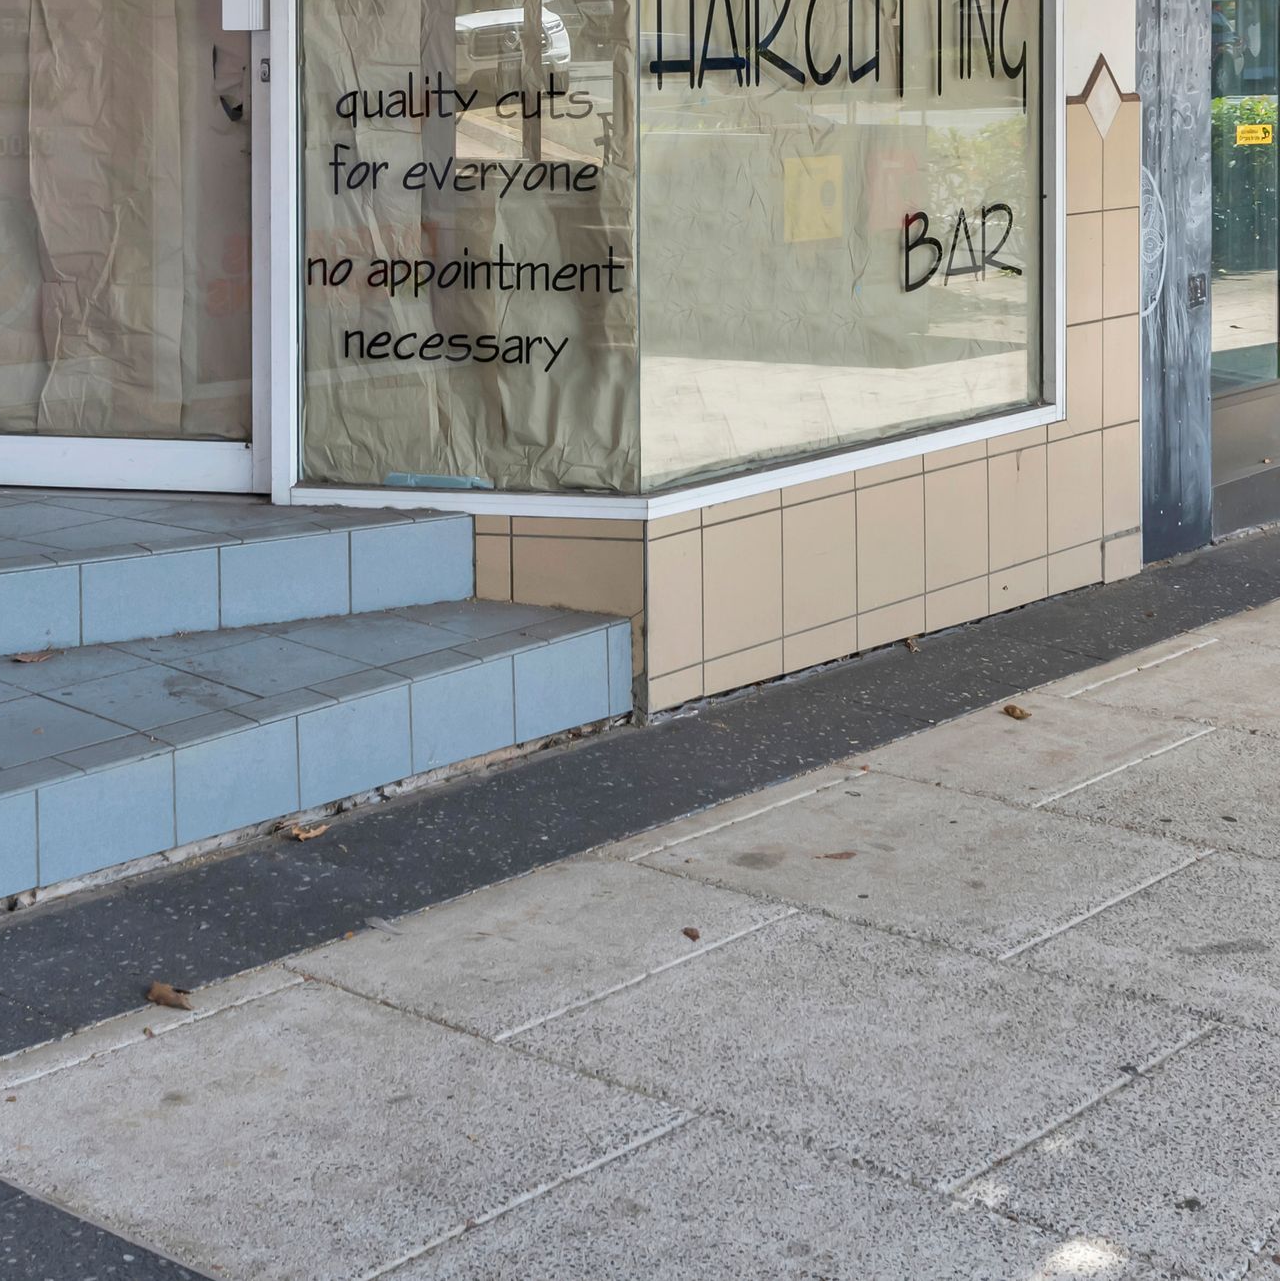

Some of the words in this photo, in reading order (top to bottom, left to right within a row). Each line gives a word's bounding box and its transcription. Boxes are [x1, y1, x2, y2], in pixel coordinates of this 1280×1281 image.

[335, 72, 477, 124] quality
[495, 72, 593, 120] cuts
[329, 144, 390, 195] for
[403, 153, 598, 200] everyone
[307, 256, 354, 287] no
[367, 243, 626, 297] appointment
[903, 202, 1023, 293] BAR
[343, 327, 570, 372] necessary
